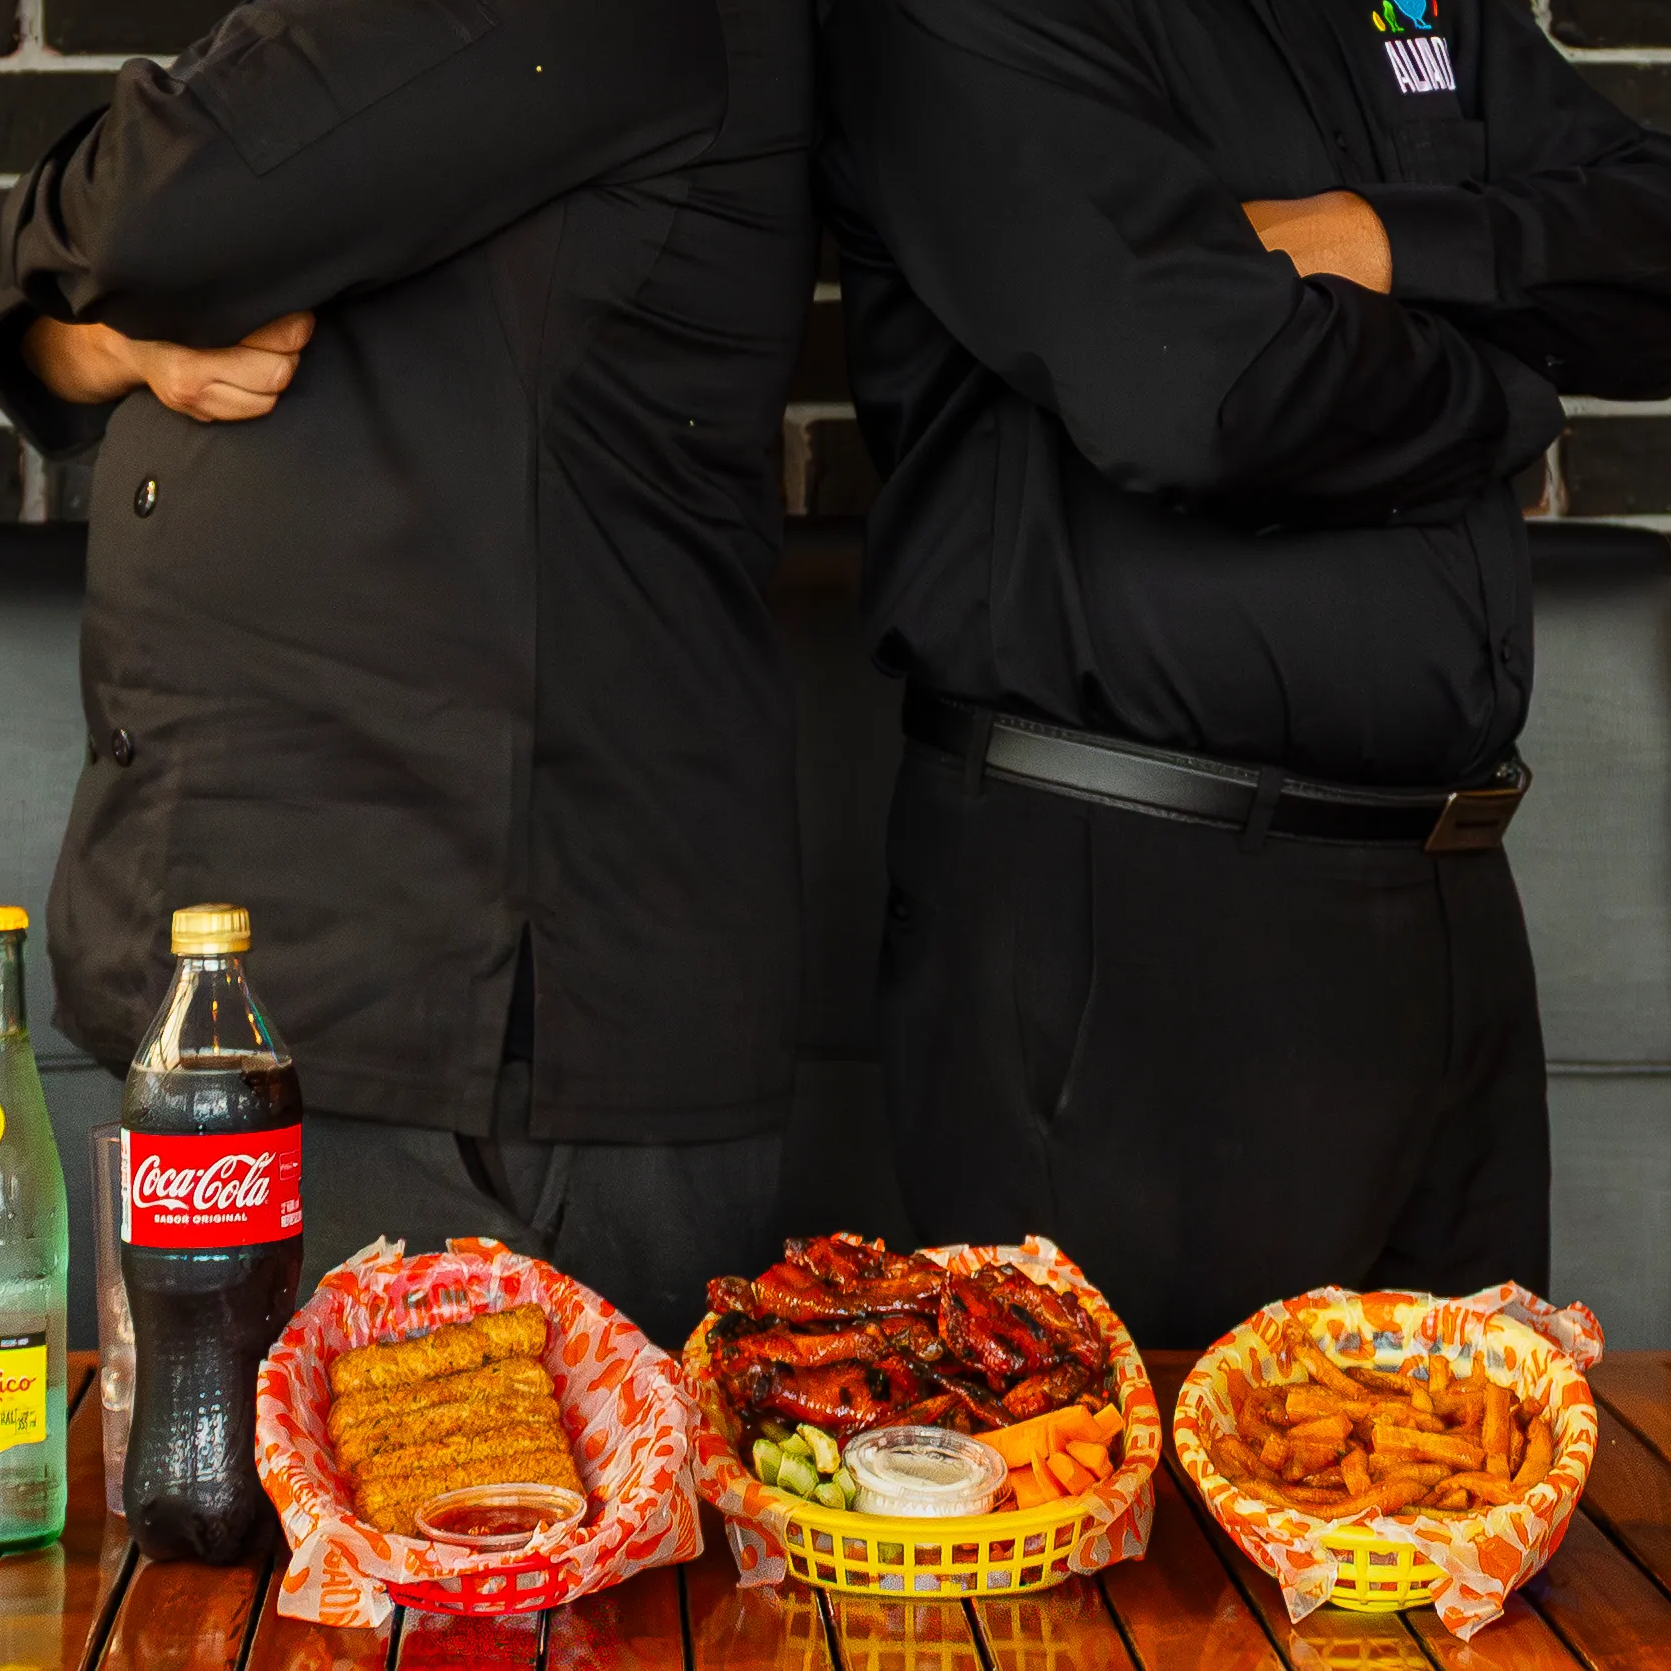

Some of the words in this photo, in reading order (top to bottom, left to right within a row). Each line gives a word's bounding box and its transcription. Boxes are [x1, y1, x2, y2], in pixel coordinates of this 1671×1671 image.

[132, 1151, 277, 1211] Coca-Cola
[153, 1213, 190, 1224] SABOR
[192, 1212, 248, 1225] ORIGINAL
